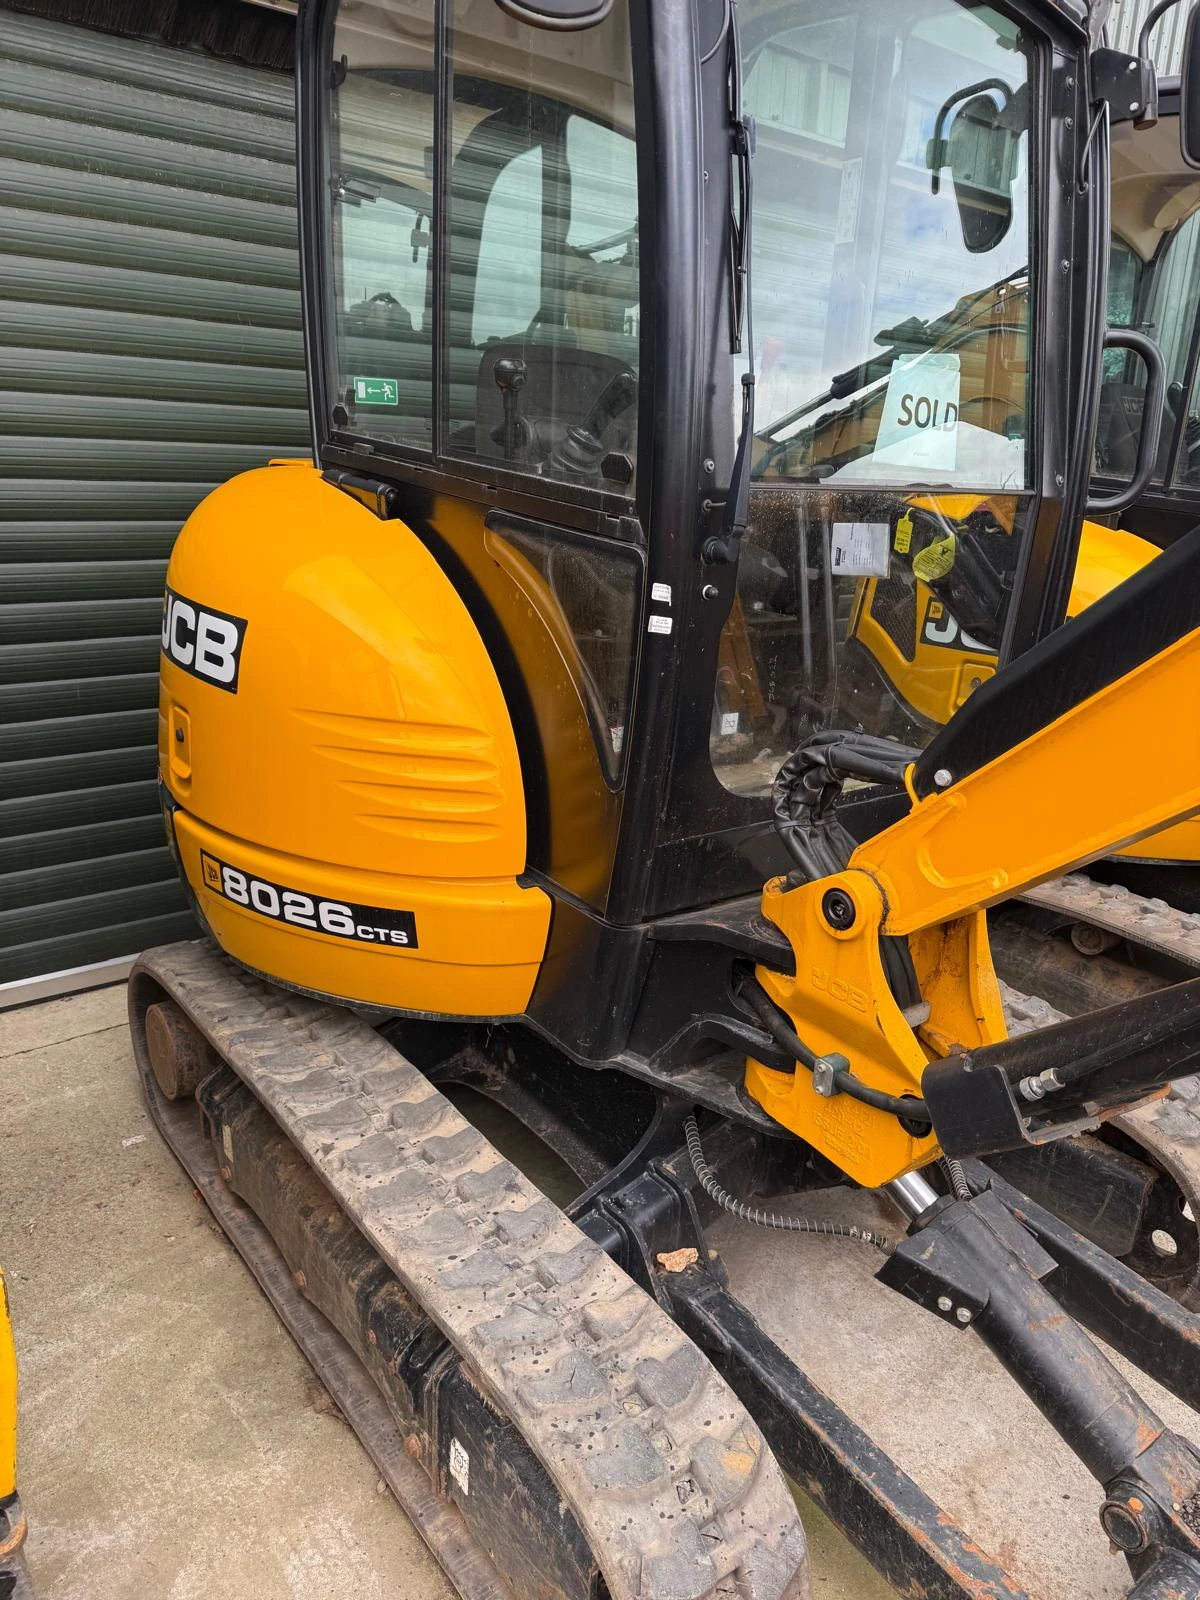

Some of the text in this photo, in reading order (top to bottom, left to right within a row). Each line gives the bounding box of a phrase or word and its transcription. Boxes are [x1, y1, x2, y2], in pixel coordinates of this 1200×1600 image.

[897, 393, 958, 432] SOLD
[161, 594, 239, 683] JCB
[222, 866, 409, 944] 8026 CTS
[811, 967, 868, 1013] JCB
